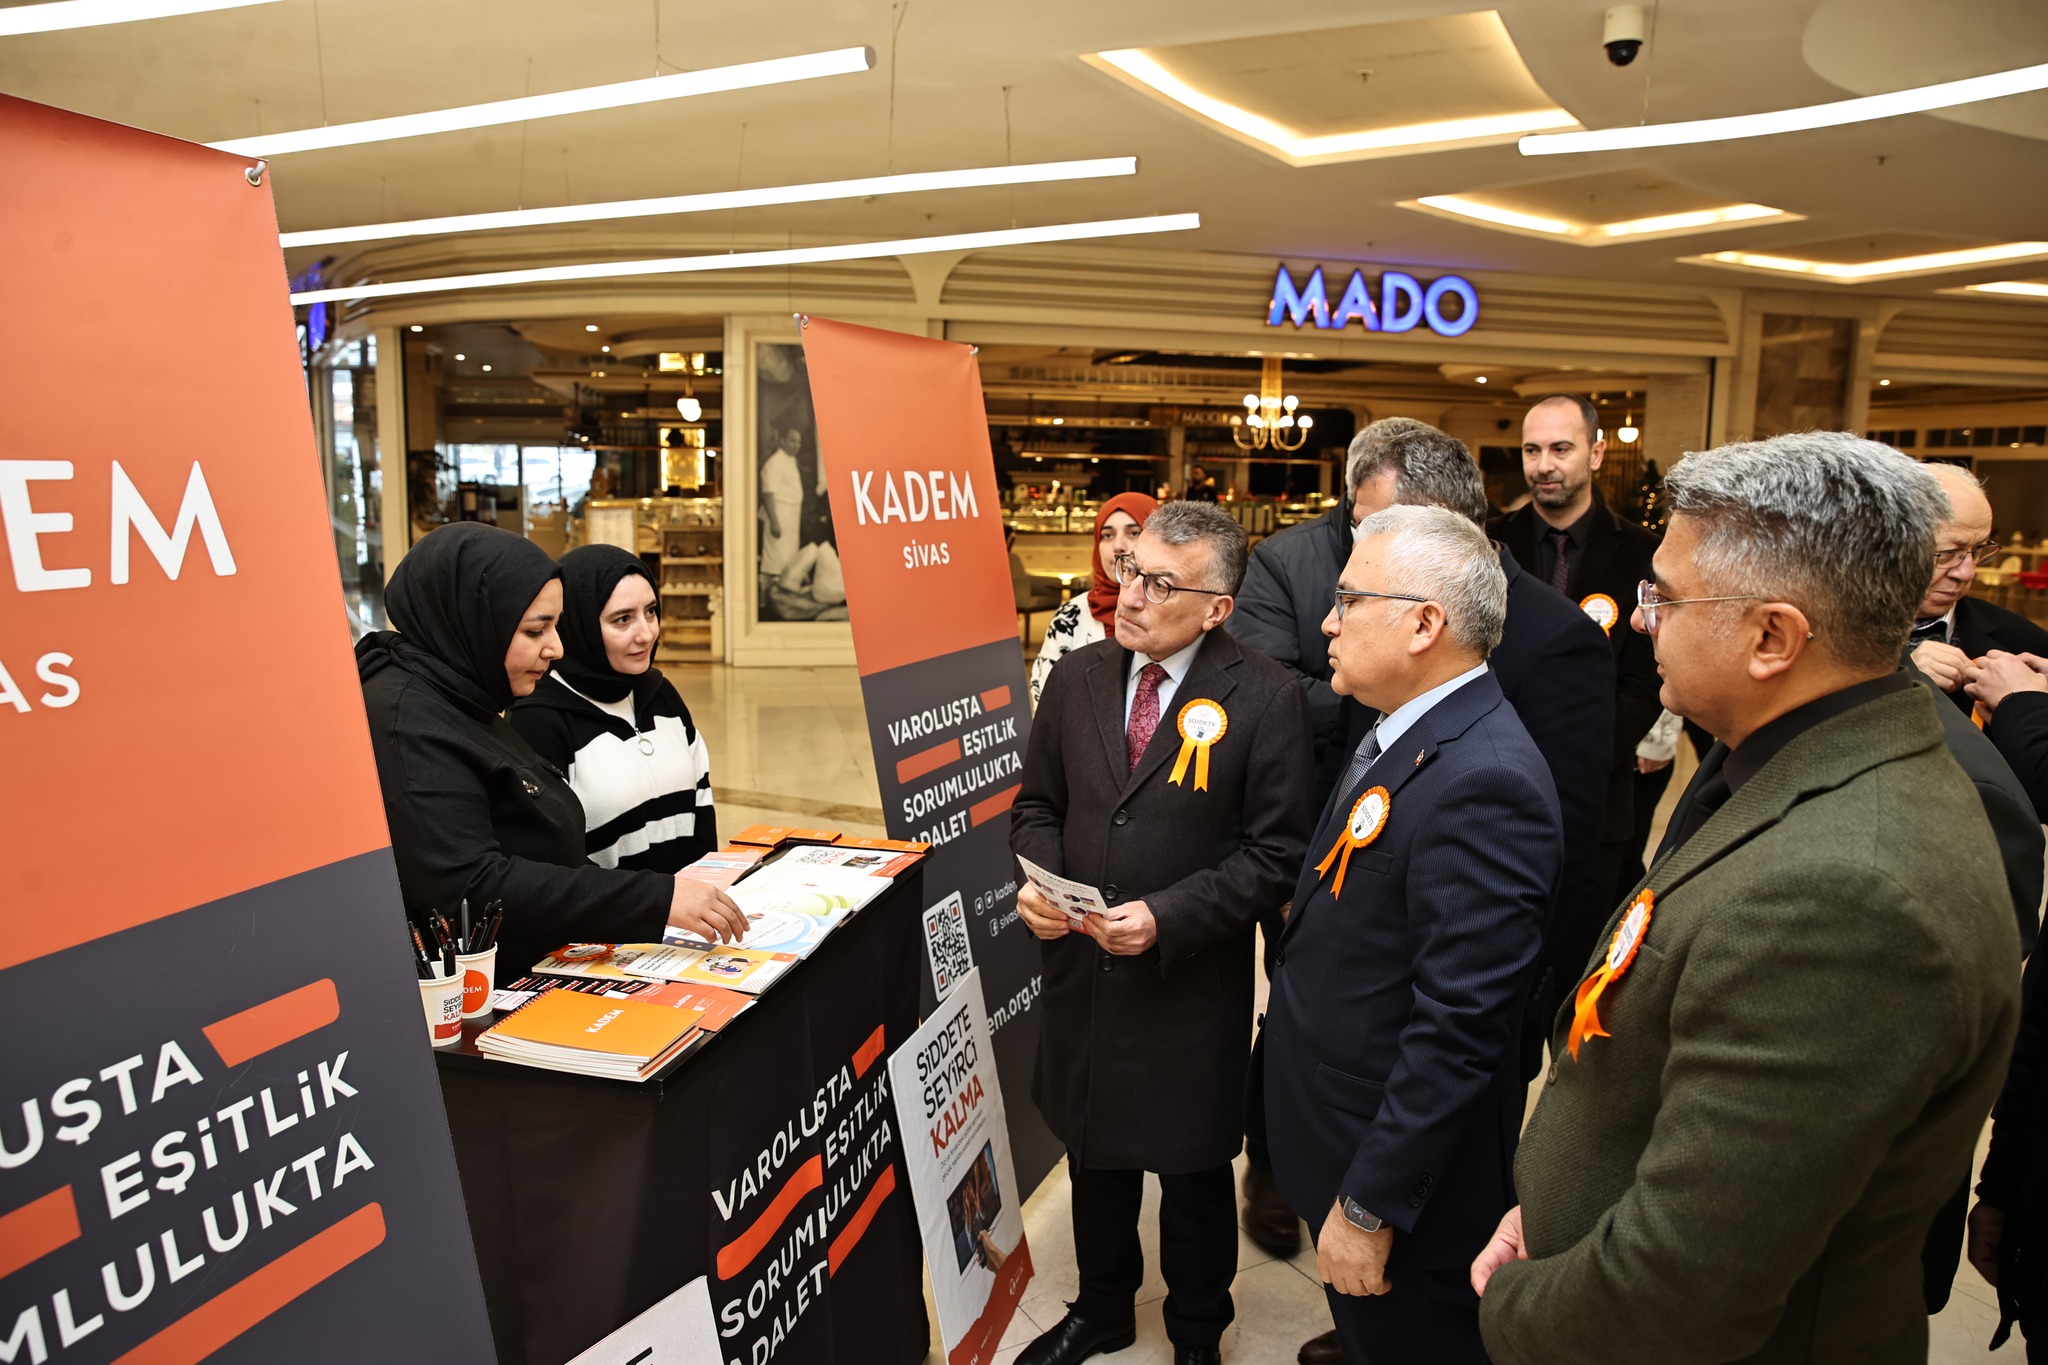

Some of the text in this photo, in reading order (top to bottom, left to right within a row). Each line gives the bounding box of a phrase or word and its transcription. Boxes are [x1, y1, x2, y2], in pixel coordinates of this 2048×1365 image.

[1265, 263, 1478, 337] MADO
[851, 470, 979, 525] KADEM
[903, 539, 950, 569] SİVAS
[888, 695, 982, 747] VAROLUŞTA
[903, 751, 1023, 823] SORUMLULUKTA
[585, 1009, 624, 1034] KADEM
[711, 1065, 852, 1221] VAROLUŞTA
[930, 1074, 984, 1159] KALMA
[729, 1259, 828, 1365] DALET
